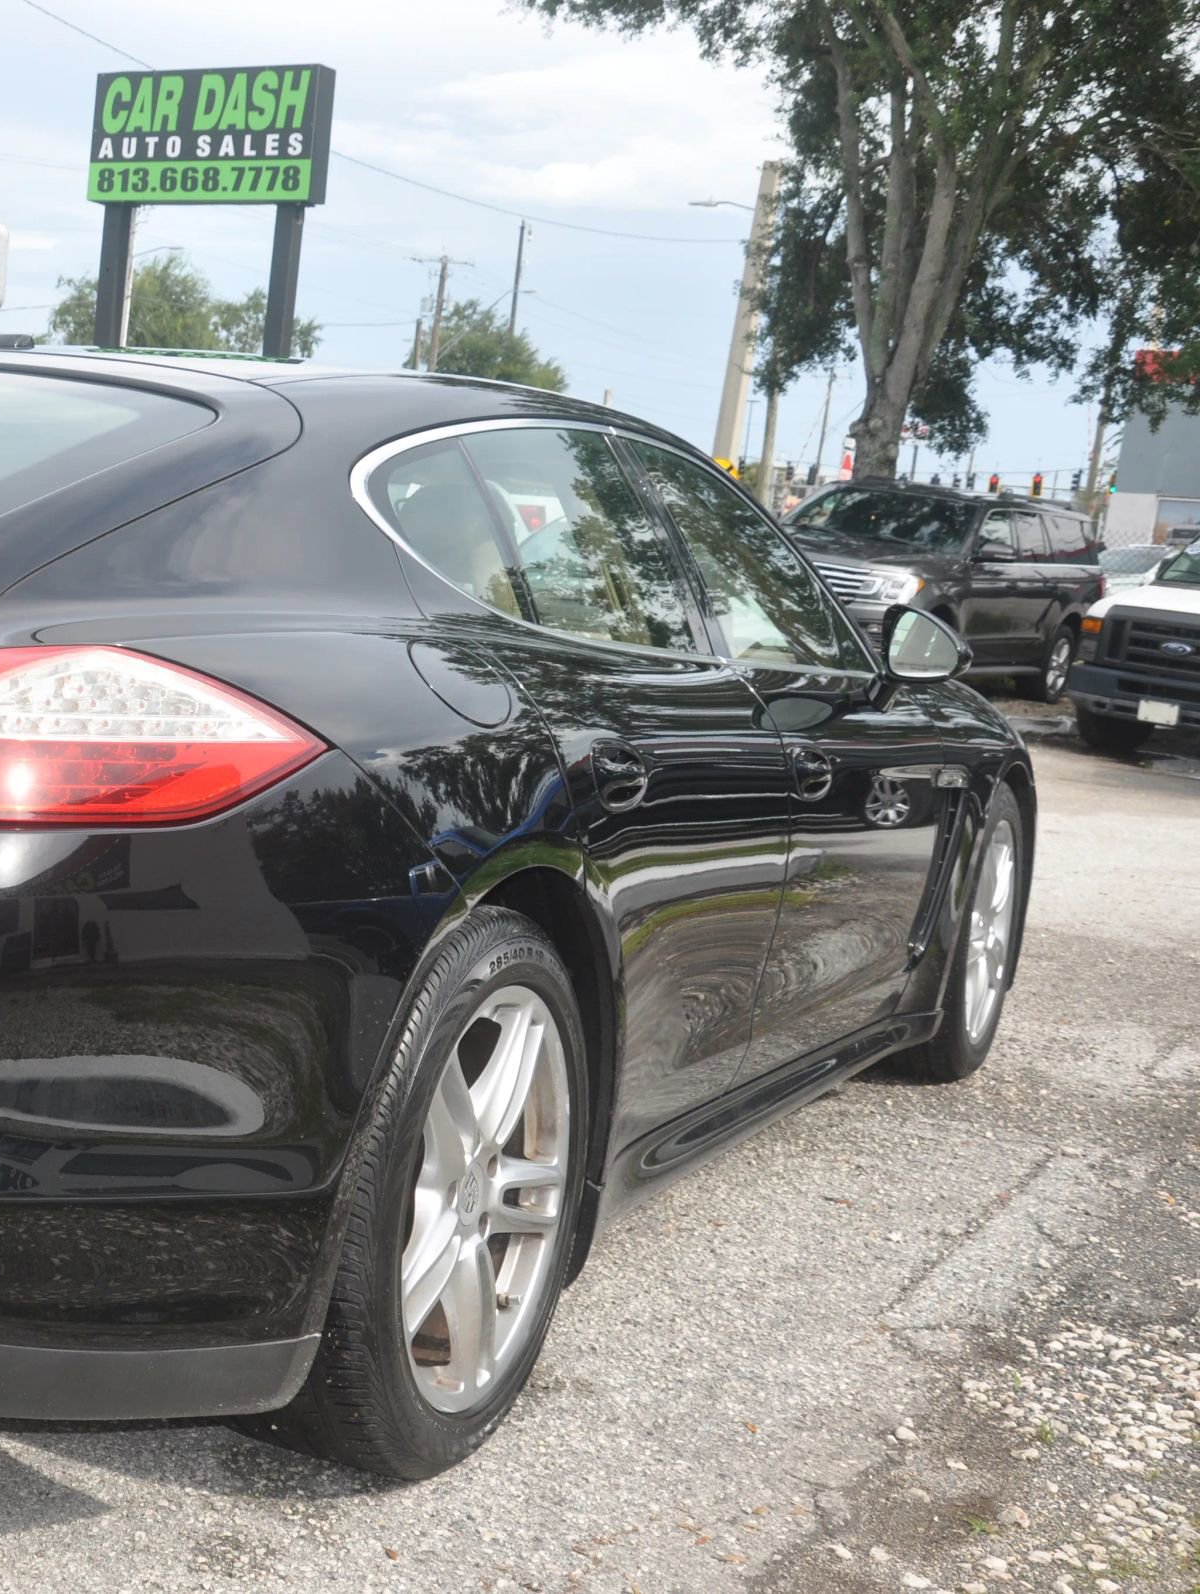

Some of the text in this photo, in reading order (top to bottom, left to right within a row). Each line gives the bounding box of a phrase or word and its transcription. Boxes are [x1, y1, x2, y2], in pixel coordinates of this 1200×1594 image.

[102, 70, 311, 134] CAR DASH
[98, 132, 303, 159] AUTO SALES
[97, 165, 301, 193] 813.668.7778
